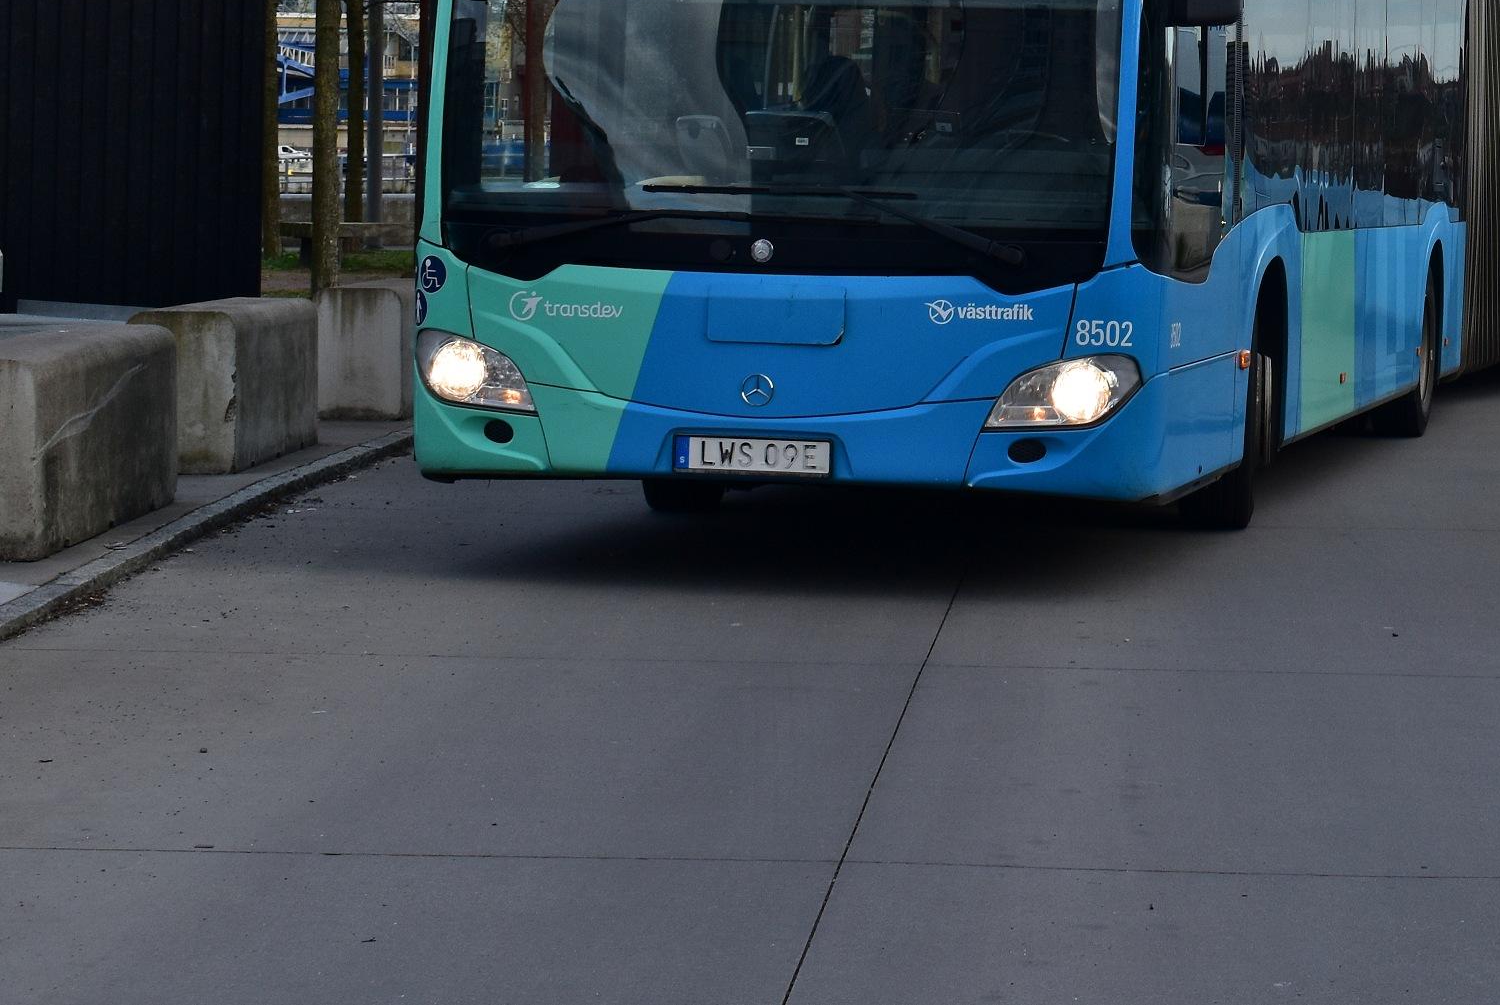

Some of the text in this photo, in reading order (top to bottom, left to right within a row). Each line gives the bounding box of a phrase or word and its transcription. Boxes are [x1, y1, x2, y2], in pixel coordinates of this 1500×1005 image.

[544, 300, 624, 318] transdev
[957, 303, 1034, 321] västtrafik
[1075, 319, 1134, 347] 8502
[701, 440, 753, 467] LWS
